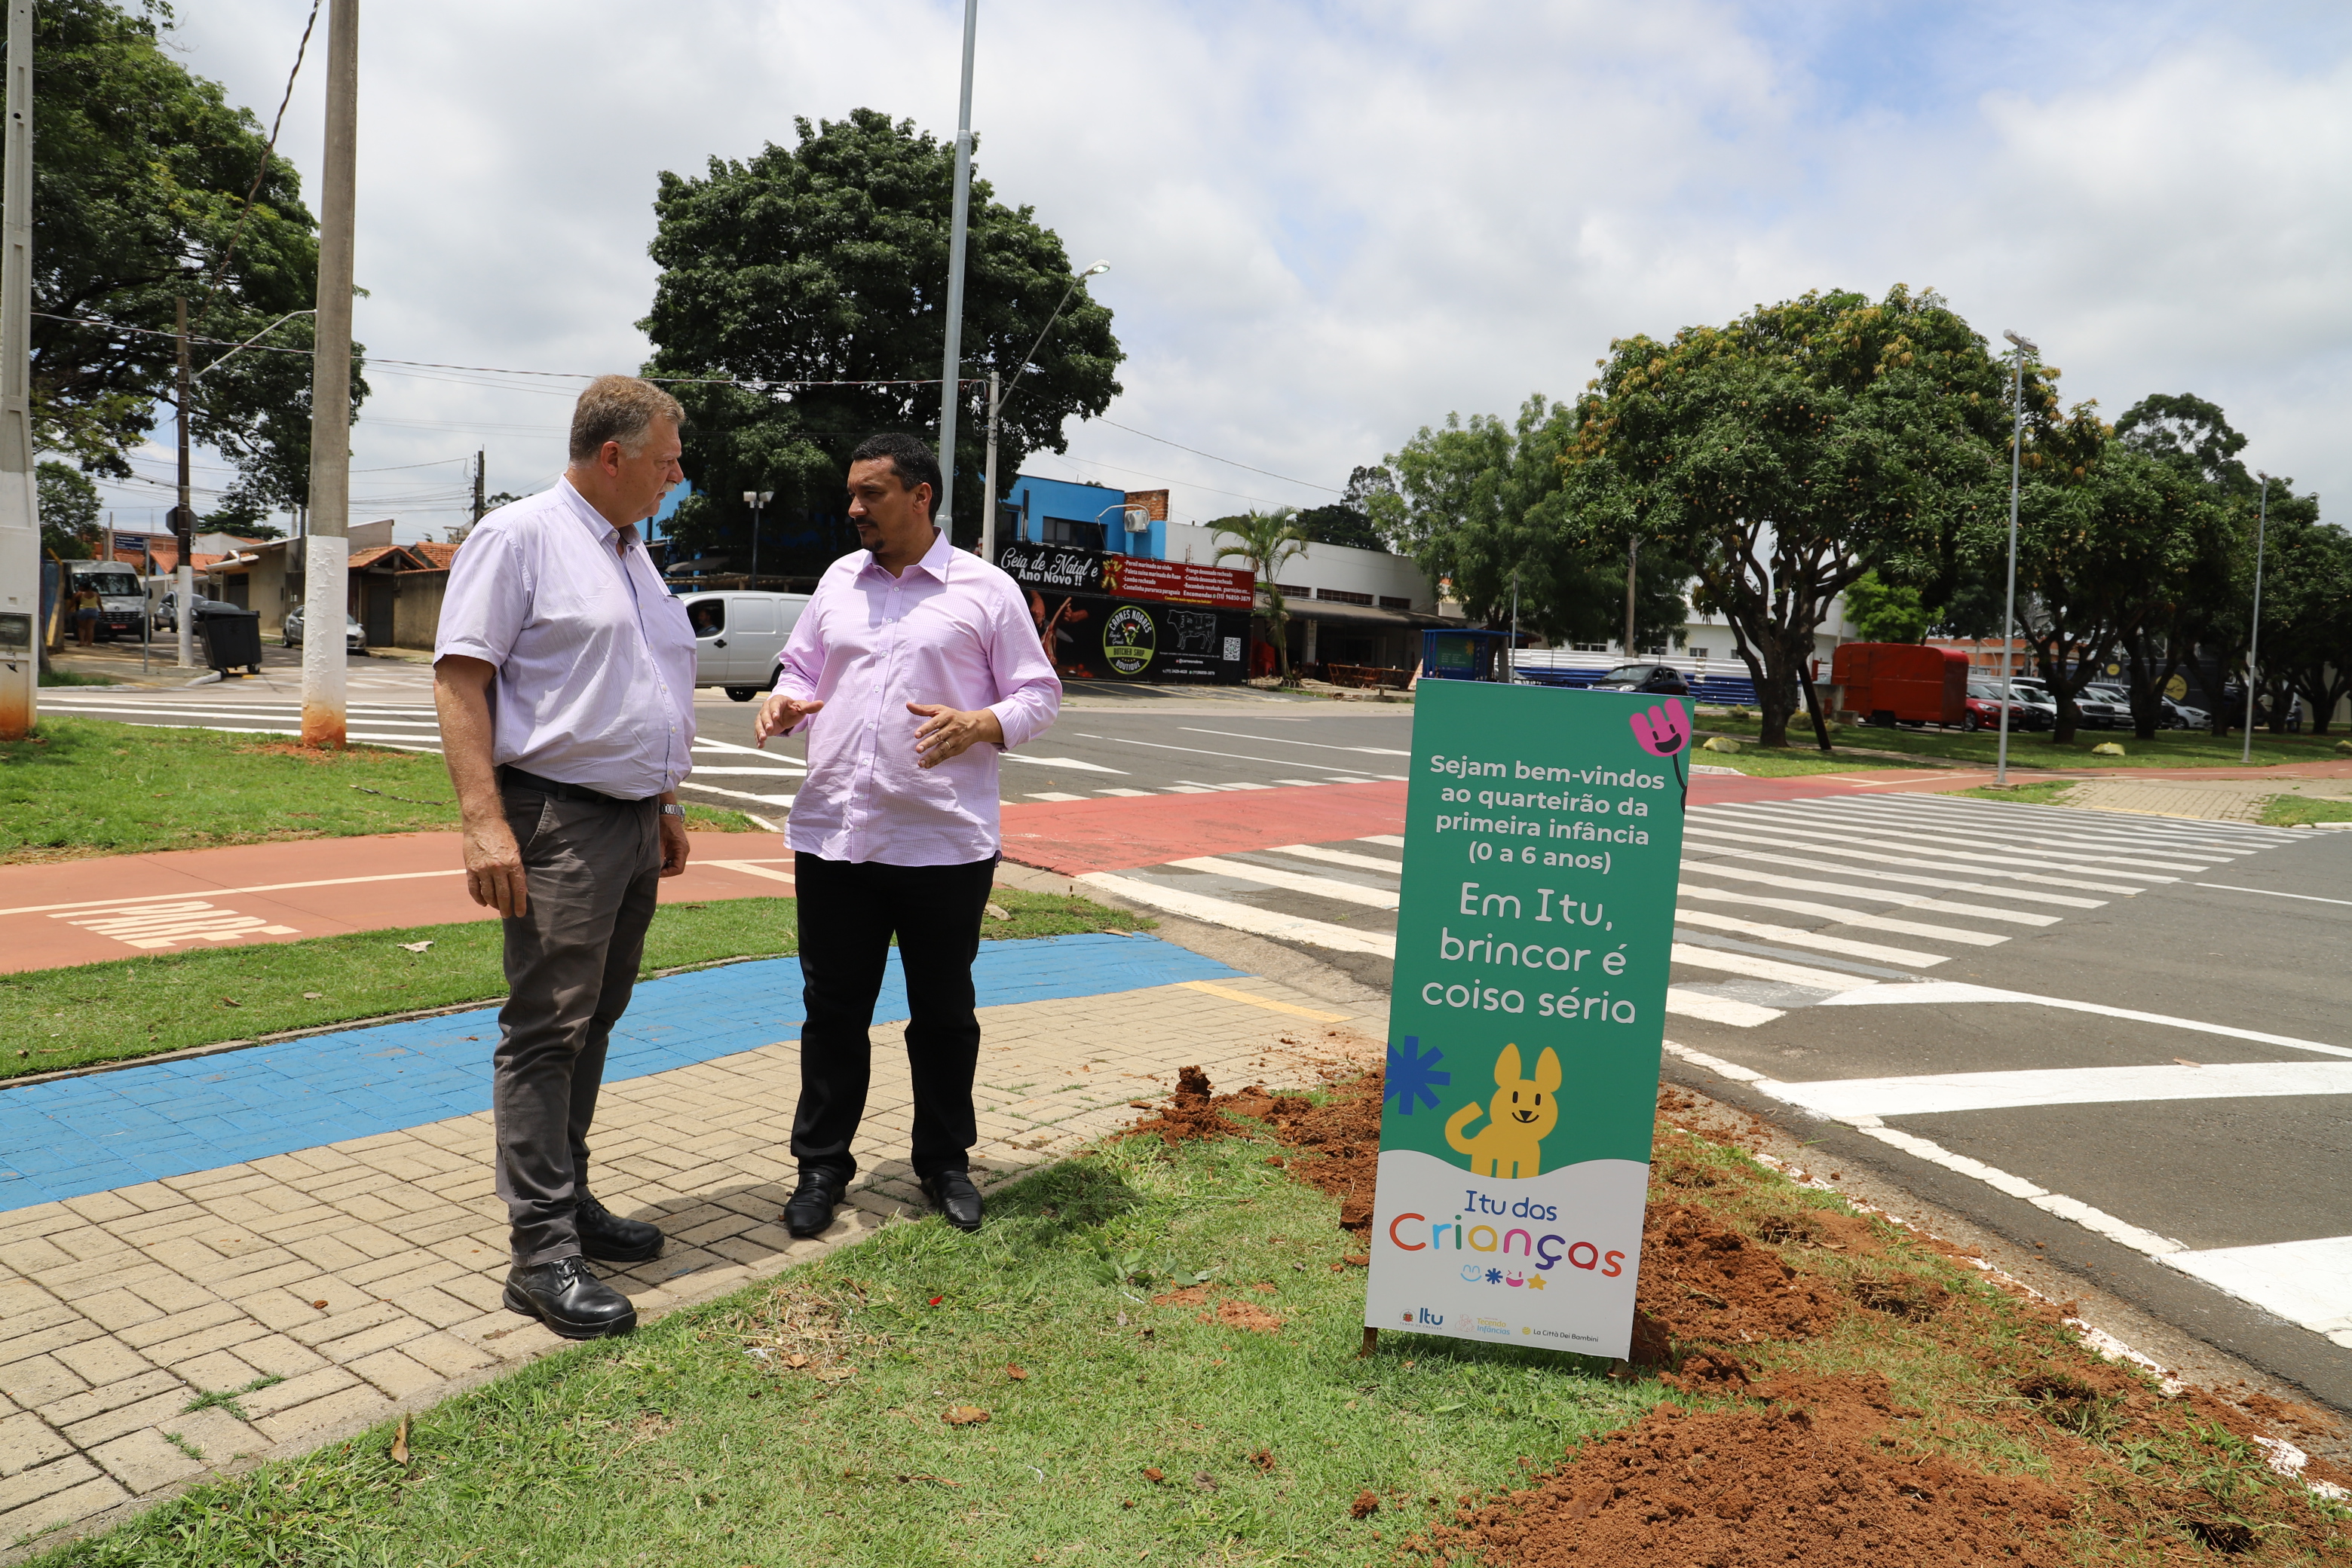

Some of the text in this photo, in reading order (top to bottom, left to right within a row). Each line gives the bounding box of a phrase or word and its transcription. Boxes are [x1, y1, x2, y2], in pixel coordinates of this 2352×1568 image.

[1000, 547, 1098, 577] Ceia de Natal e
[1018, 568, 1041, 582] Ano
[1043, 571, 1072, 585] Novo
[1183, 590, 1212, 599] Encomendas
[1225, 594, 1251, 602] 96850-3879
[1109, 609, 1153, 633] CARNES NOBRES
[1113, 648, 1145, 657] BUTCHER SHOP
[1115, 659, 1141, 671] BOUTIQUE
[1430, 755, 1665, 790] Sejam bem-vindos
[1441, 787, 1649, 817] ao quarteirão da
[1435, 811, 1649, 845] primeira infância
[1468, 841, 1612, 874] (0 a 6 anos)
[1459, 881, 1613, 932] Em Itu,
[1440, 927, 1628, 975] brincar é
[1422, 978, 1637, 1024] coisa séria
[1464, 1190, 1557, 1221] Itu das
[1389, 1213, 1626, 1278] Crianças
[1419, 1307, 1444, 1326] Itu
[1477, 1318, 1507, 1328] Tecendo
[1477, 1325, 1511, 1335] Infâncias
[1572, 1334, 1599, 1343] Bambini
